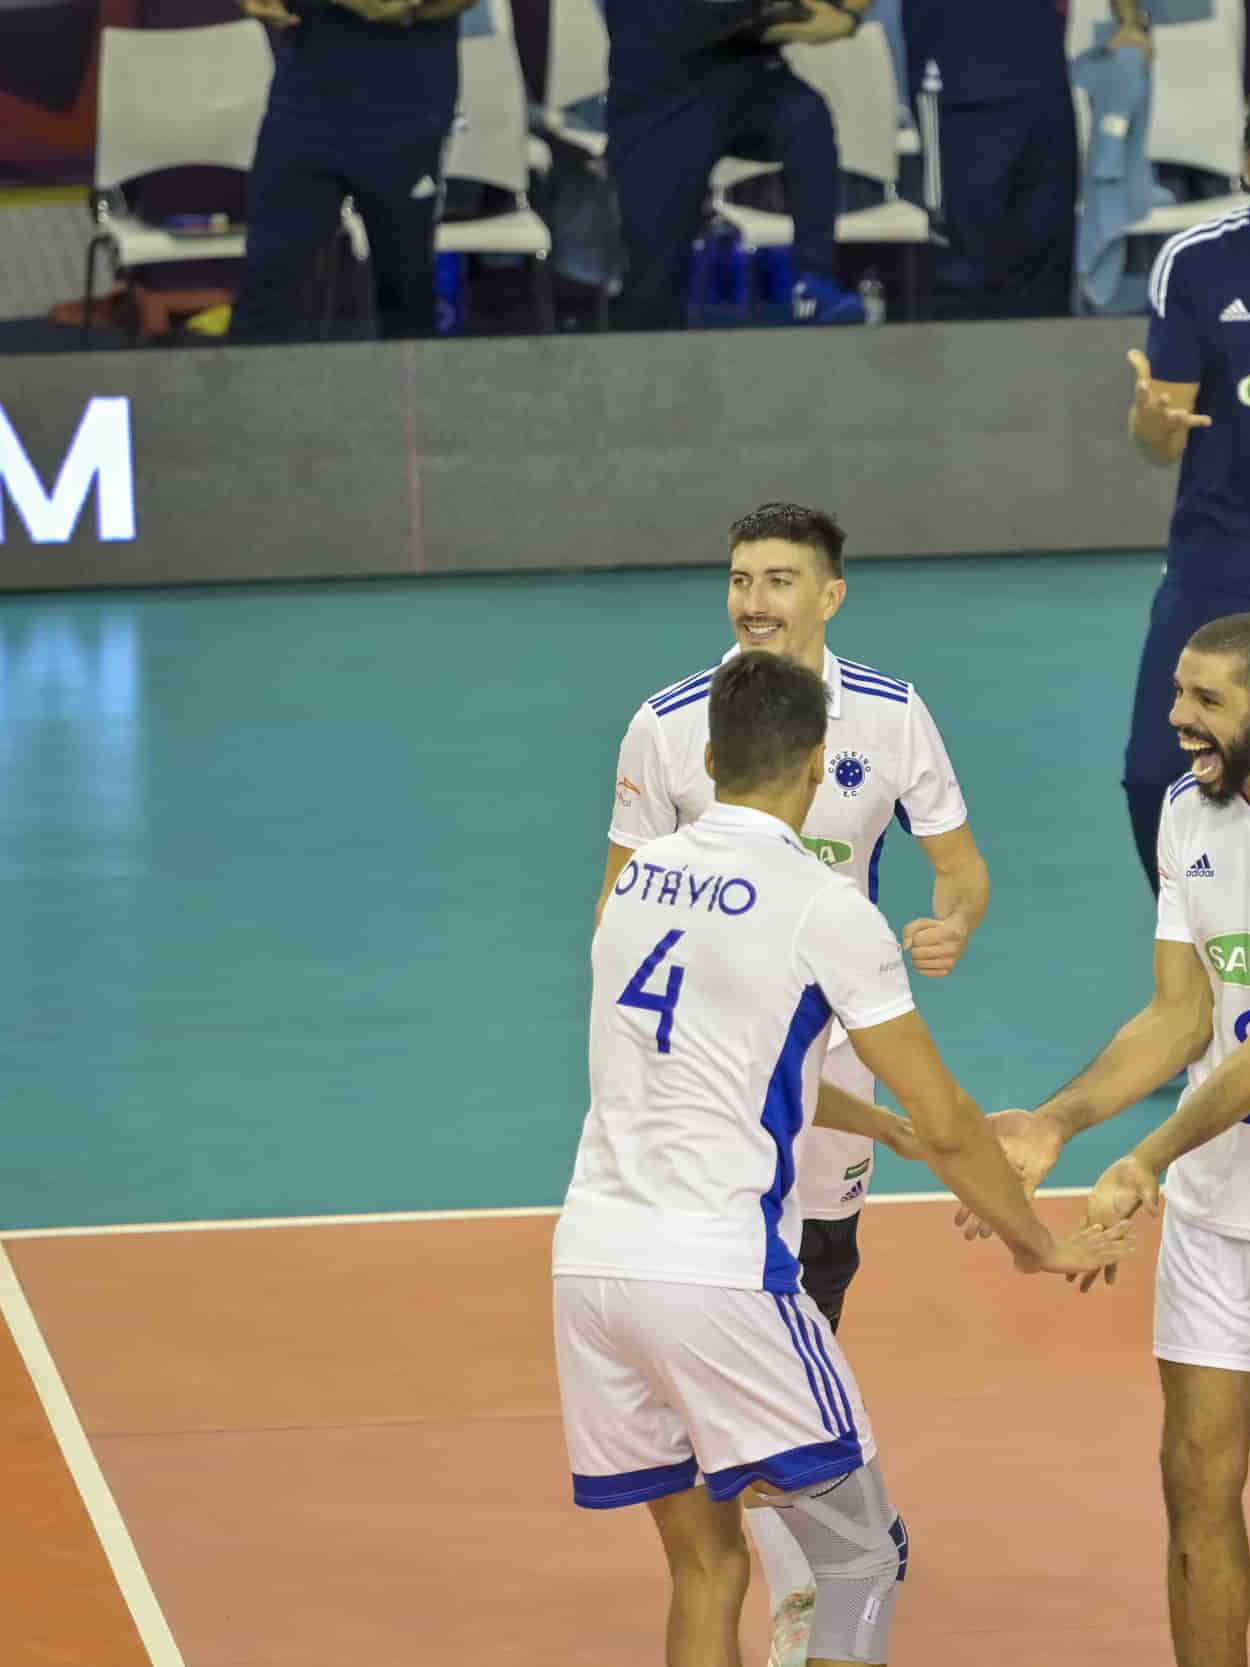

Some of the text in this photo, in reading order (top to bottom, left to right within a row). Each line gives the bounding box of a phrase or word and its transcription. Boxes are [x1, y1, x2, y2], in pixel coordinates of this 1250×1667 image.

[615, 860, 757, 915] OTÁVIO
[1185, 870, 1215, 878] adidas
[616, 929, 686, 1054] 4
